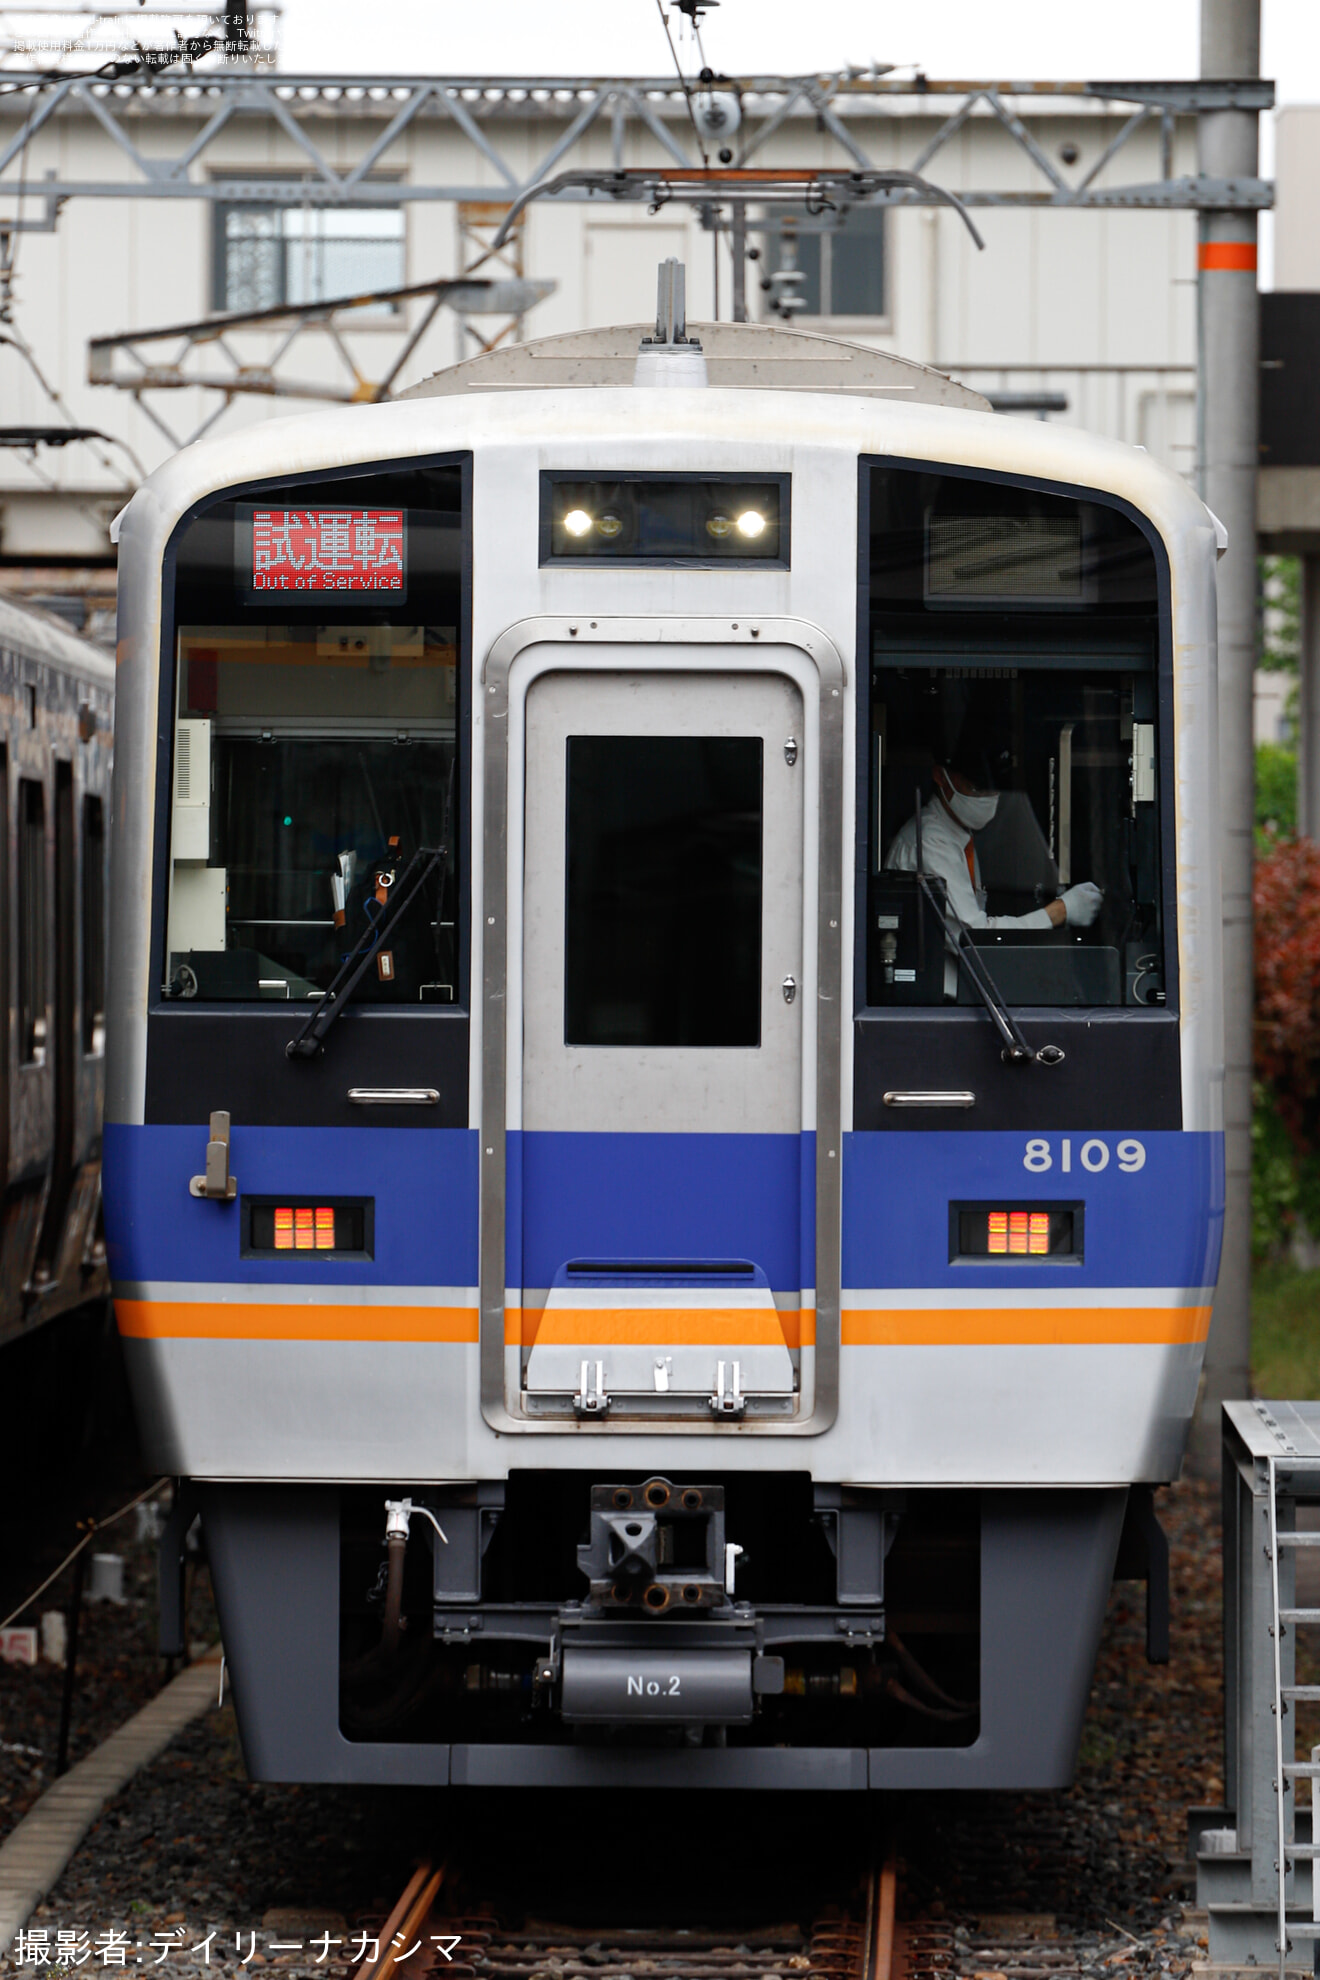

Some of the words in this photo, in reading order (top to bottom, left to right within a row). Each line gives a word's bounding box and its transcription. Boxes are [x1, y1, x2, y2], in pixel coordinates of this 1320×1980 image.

[253, 511, 403, 571] 試運転
[253, 572, 289, 590] Out
[295, 574, 317, 590] of
[323, 572, 401, 590] Service
[1023, 1138, 1147, 1173] 8109
[627, 1676, 681, 1696] No.2
